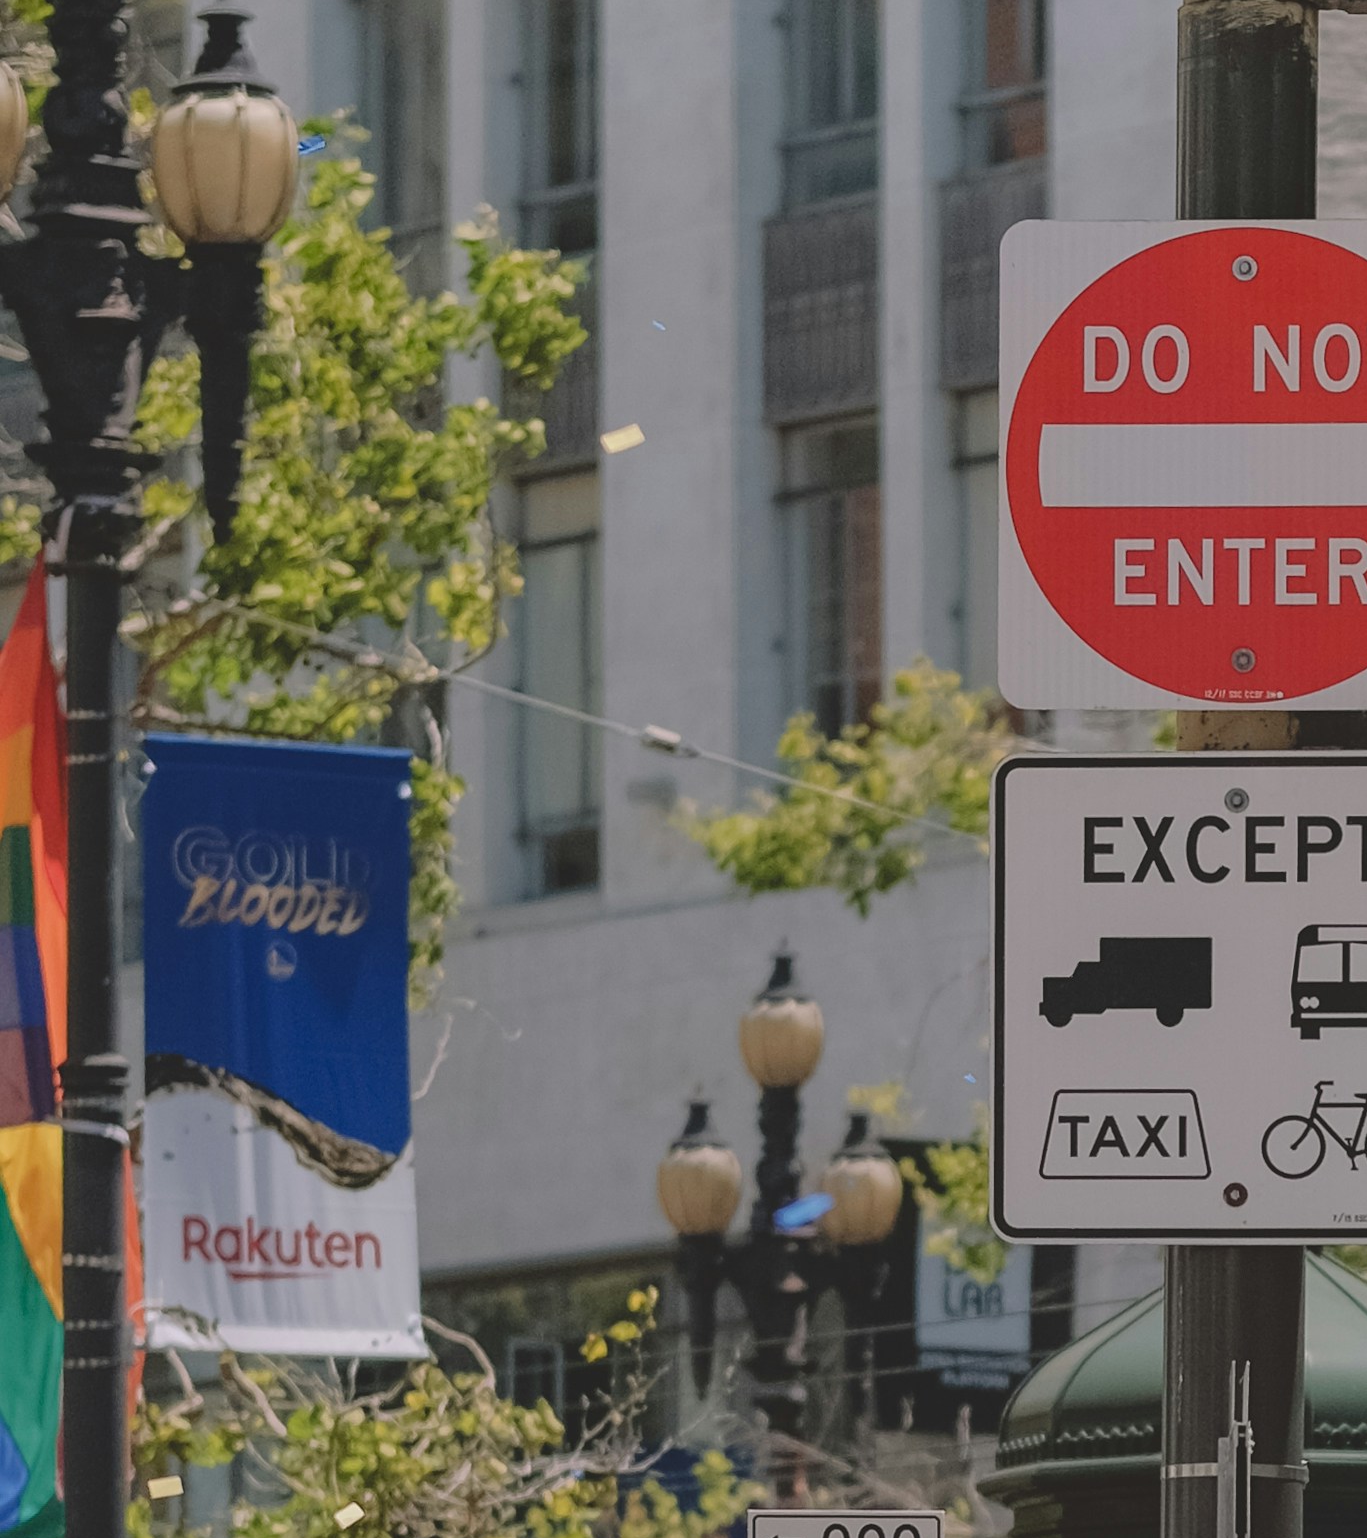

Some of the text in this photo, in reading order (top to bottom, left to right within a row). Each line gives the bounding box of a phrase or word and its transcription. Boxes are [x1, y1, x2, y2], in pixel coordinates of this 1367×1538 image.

[1082, 324, 1190, 395] DO
[1058, 1114, 1188, 1159] TAXI
[183, 1215, 382, 1269] Rakuten
